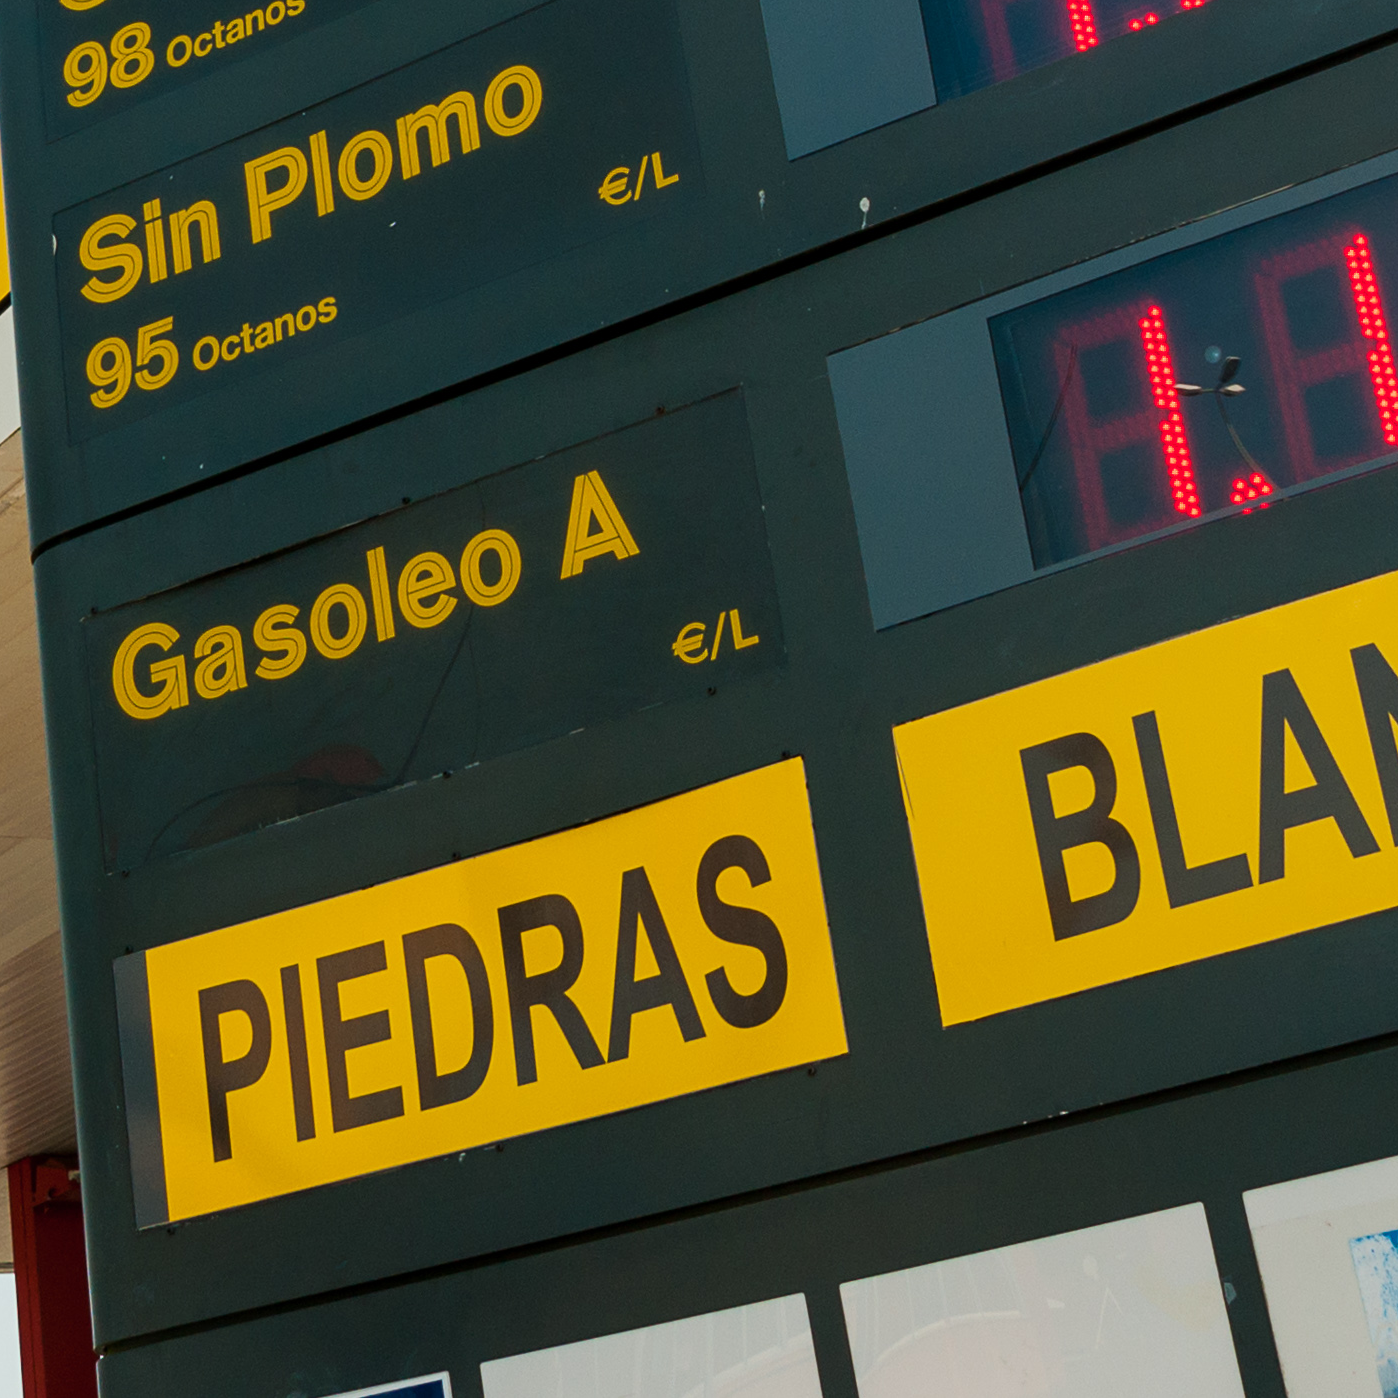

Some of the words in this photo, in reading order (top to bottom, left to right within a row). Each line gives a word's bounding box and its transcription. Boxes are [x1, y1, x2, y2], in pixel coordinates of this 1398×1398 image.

[62, 21, 155, 108] 98
[78, 197, 221, 304] Sin
[244, 64, 543, 245] Plomo
[597, 151, 680, 206] €/L
[85, 315, 180, 409] 95
[192, 296, 339, 372] Octanos
[112, 528, 521, 720] Gasoleo
[559, 469, 641, 580] A
[671, 608, 760, 665] €/L
[197, 834, 789, 1164] PIEDRAS
